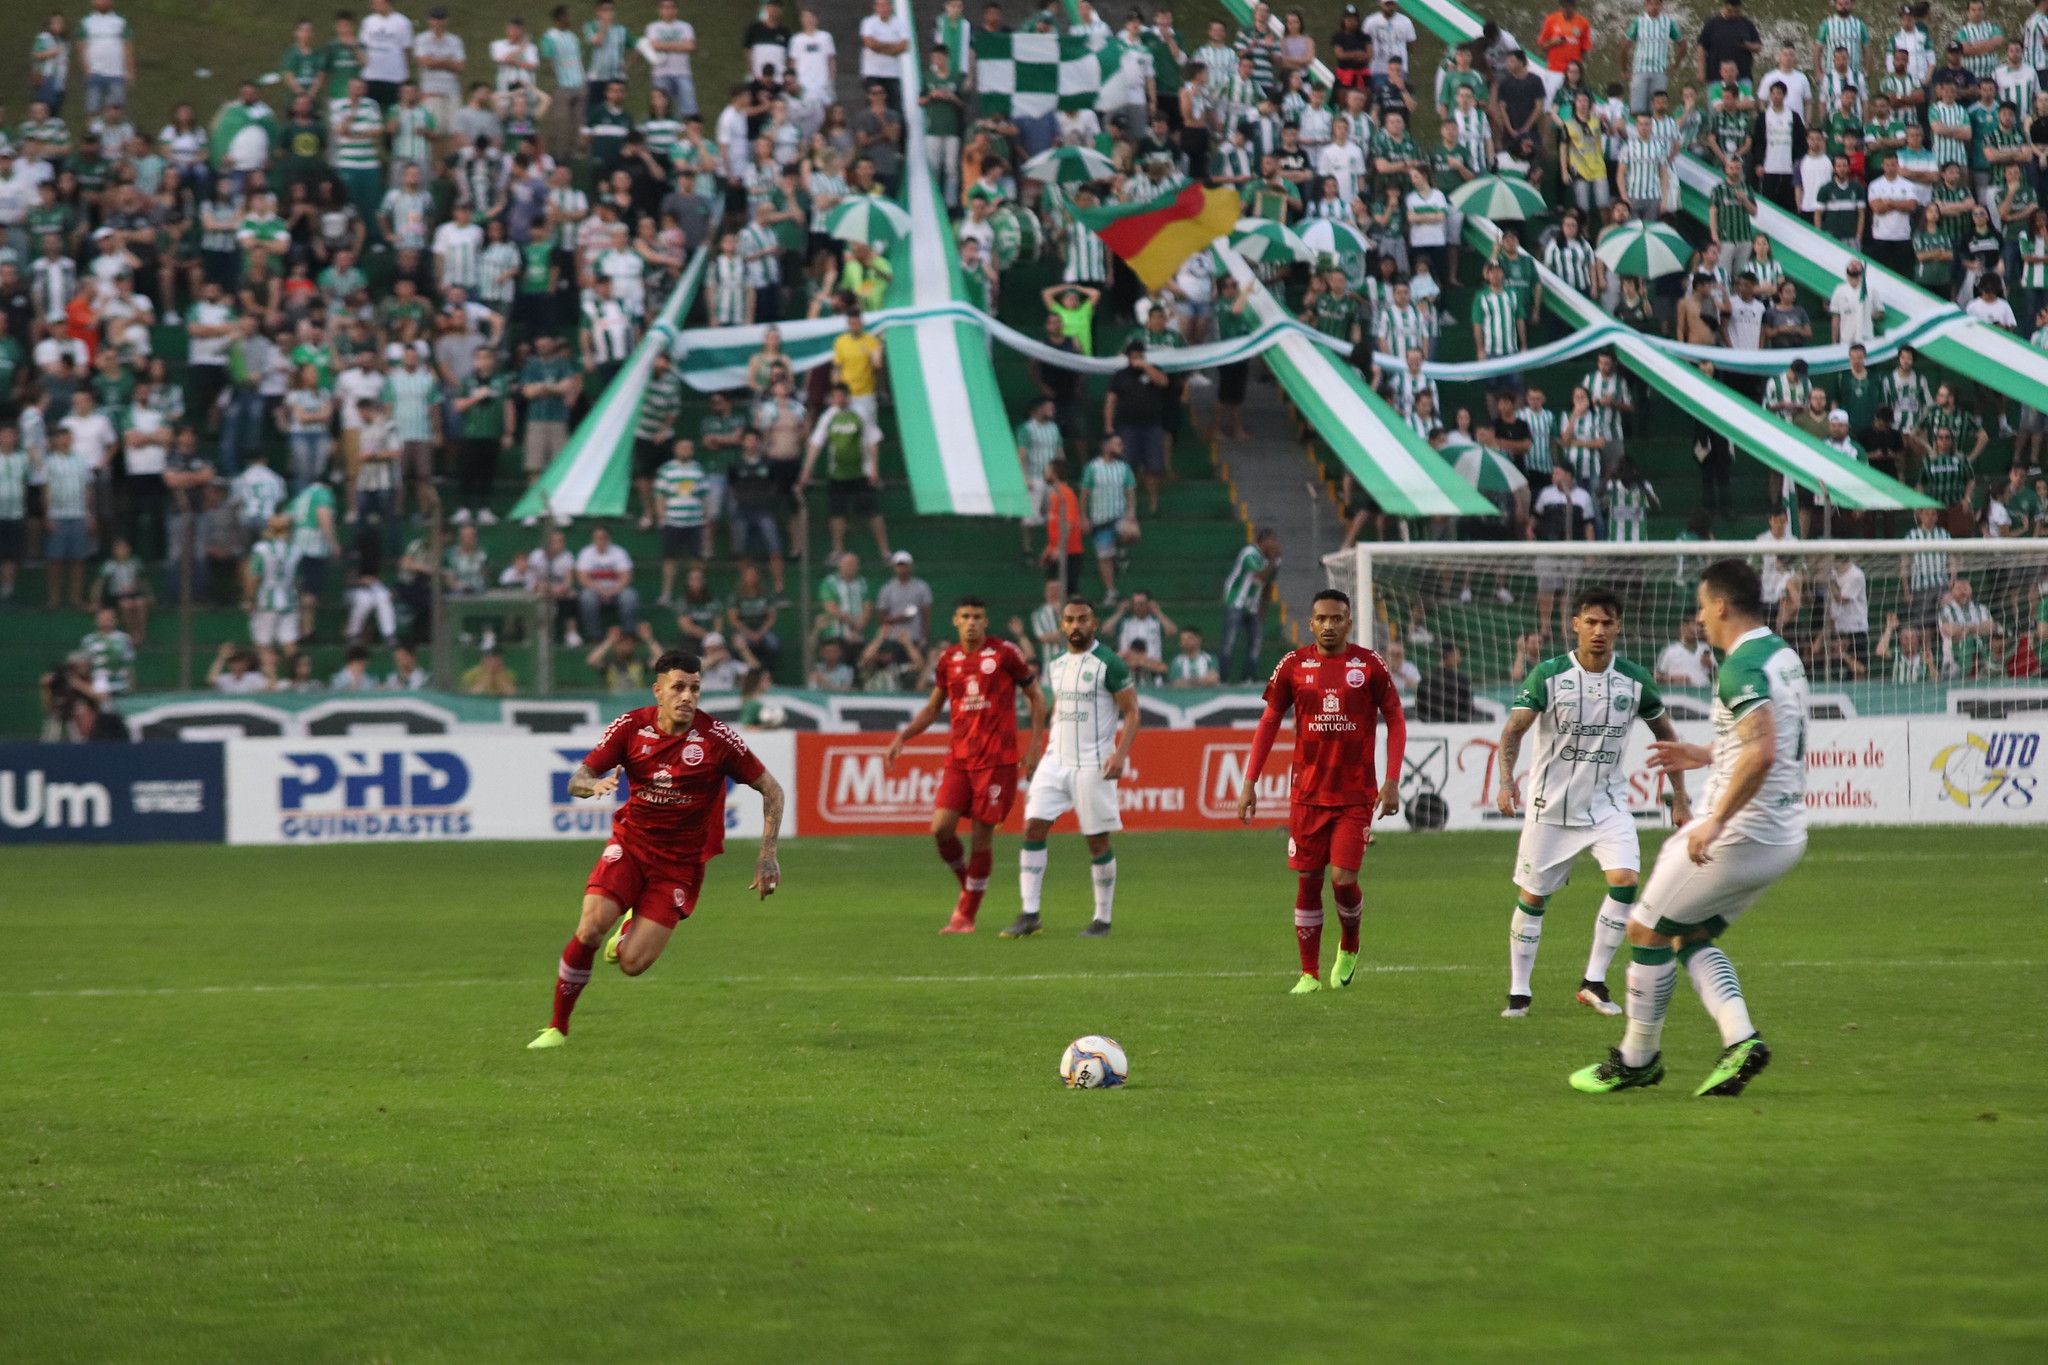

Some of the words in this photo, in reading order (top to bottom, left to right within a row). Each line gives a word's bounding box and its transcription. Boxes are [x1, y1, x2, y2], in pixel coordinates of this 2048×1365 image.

[1308, 722, 1357, 732] PORTUGUÊS
[1314, 714, 1348, 722] HOSPITAL
[1572, 721, 1627, 738] Banrisul
[1575, 749, 1617, 764] RedOil
[1863, 739, 1885, 768] de
[280, 752, 471, 809] PHD
[0, 770, 112, 828] Um
[1804, 779, 1878, 809] orcidas.
[281, 815, 472, 838] GUINDASTES
